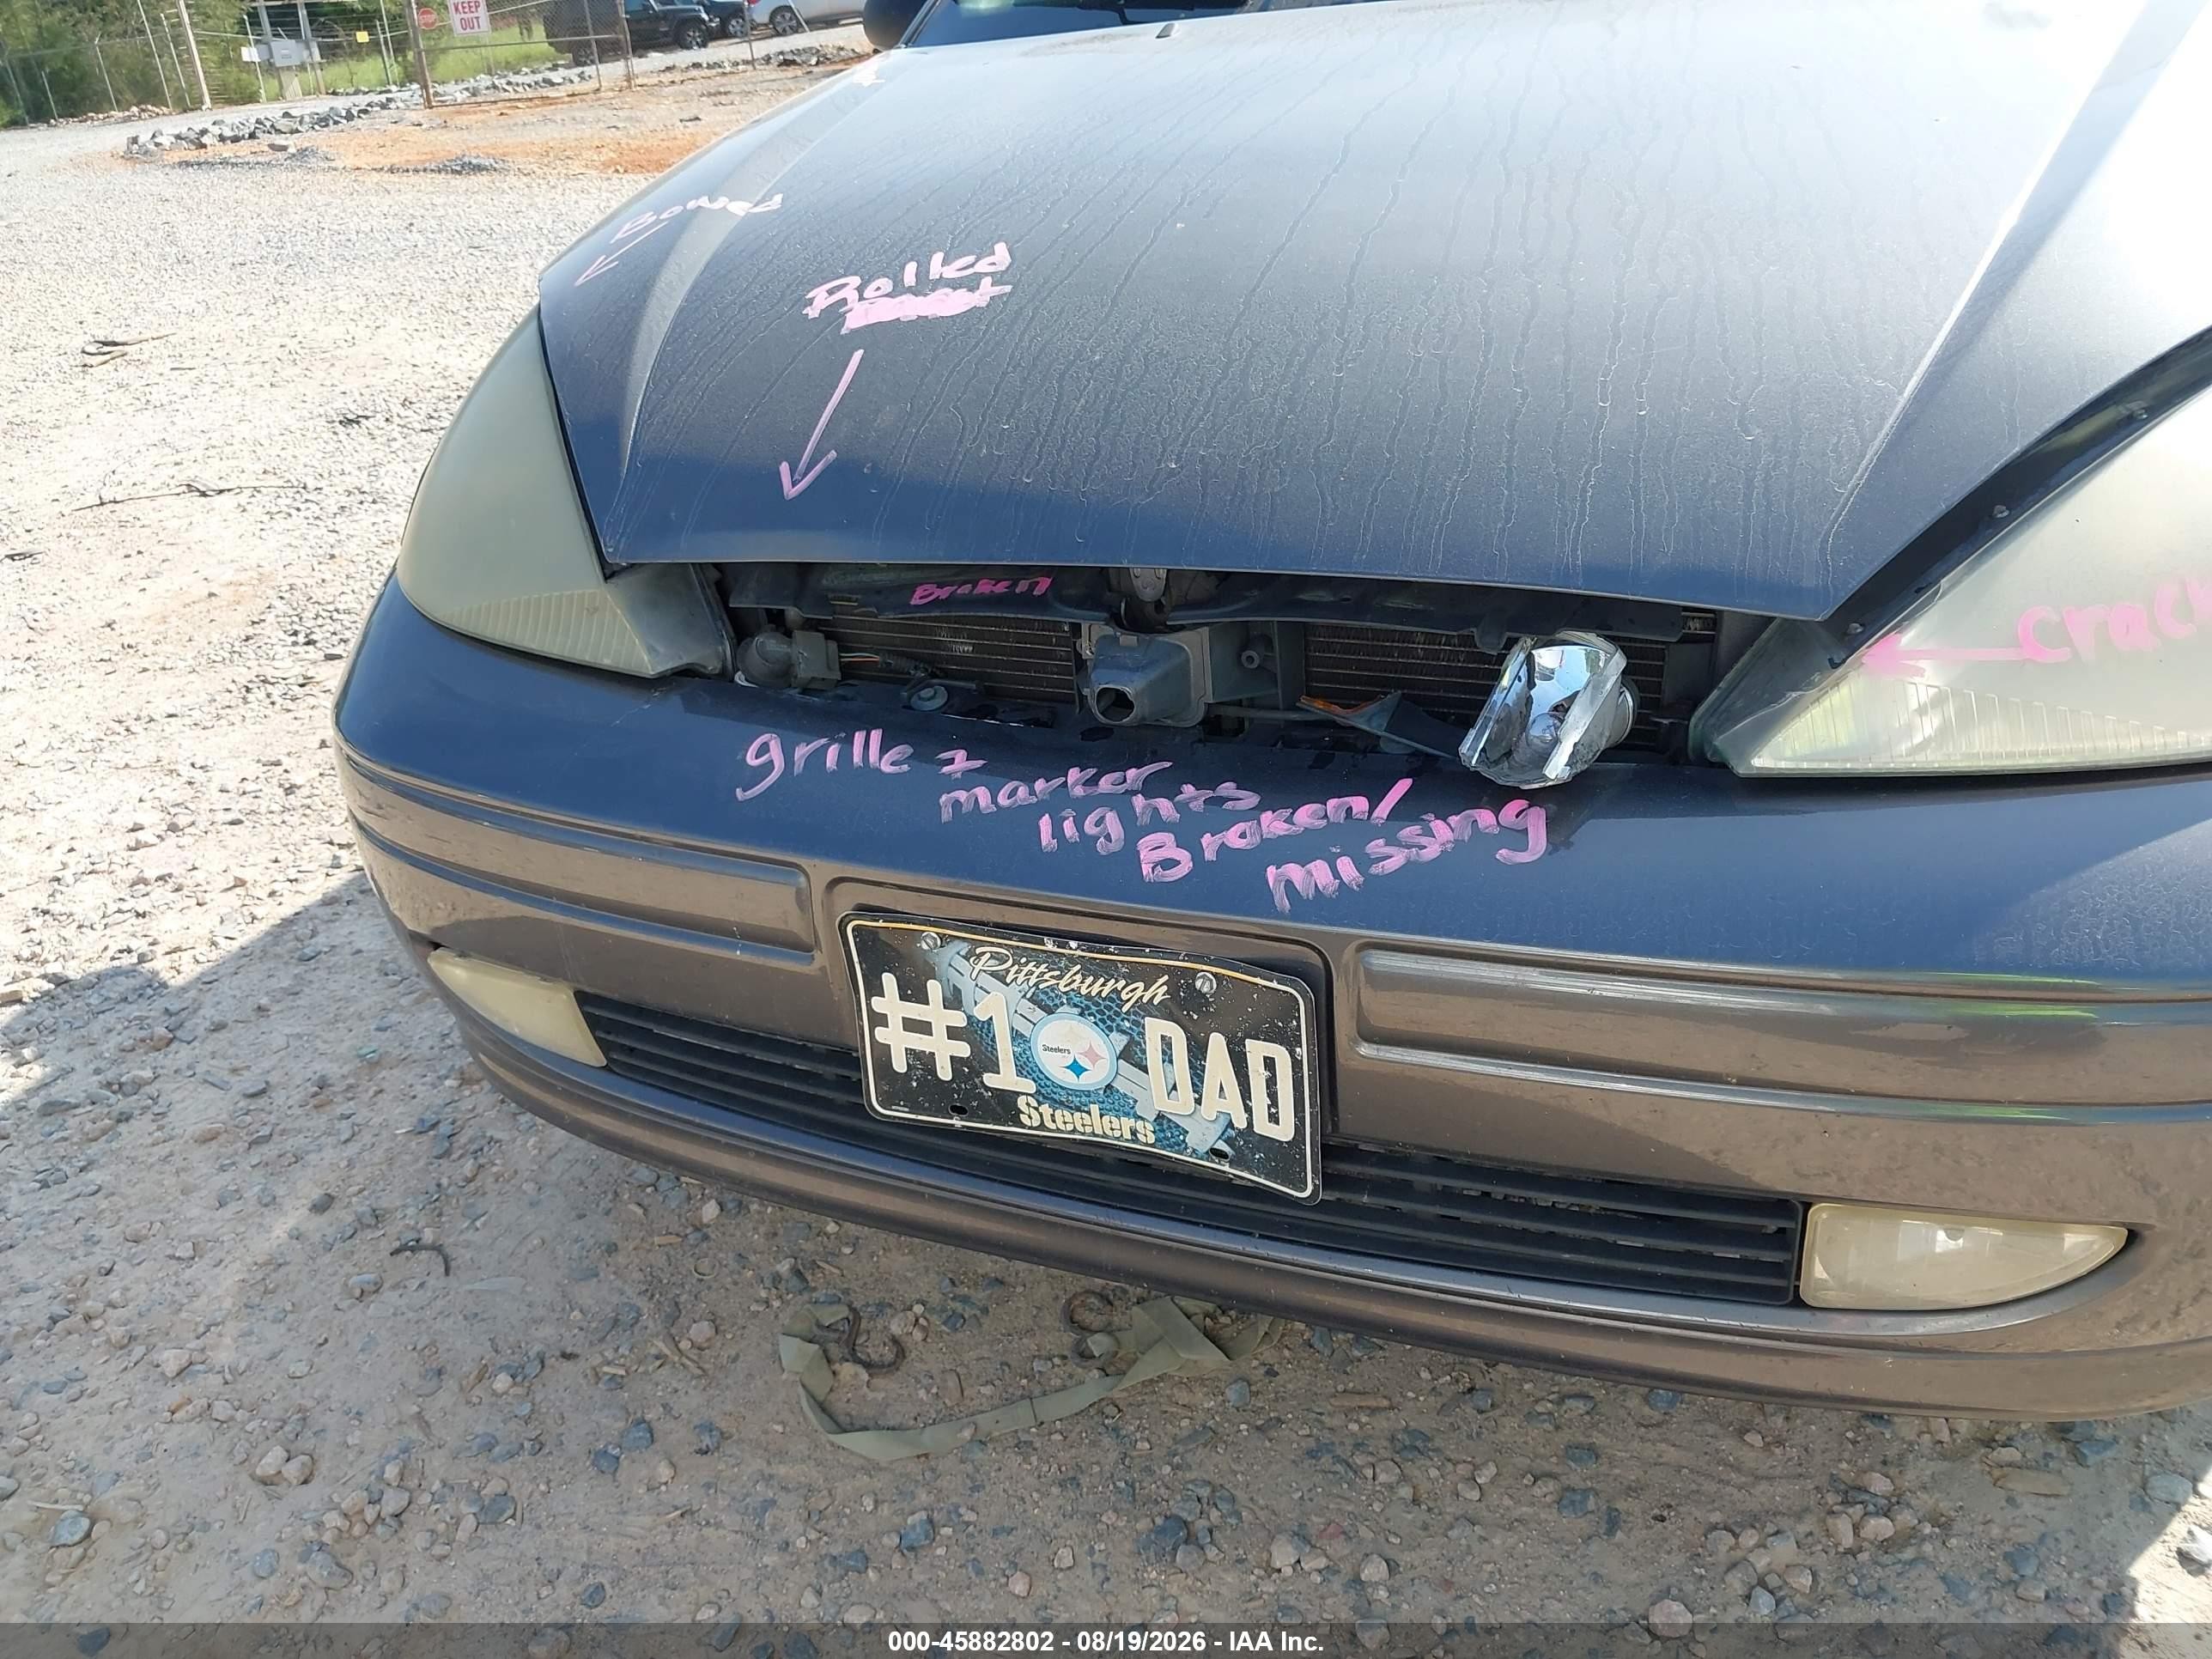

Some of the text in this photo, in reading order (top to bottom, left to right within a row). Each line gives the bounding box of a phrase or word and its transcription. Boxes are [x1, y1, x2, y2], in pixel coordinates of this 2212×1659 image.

[453, 0, 481, 15] KEEP
[460, 16, 481, 31] OUT
[802, 241, 1012, 319] Rolled
[736, 728, 914, 801] grille
[940, 761, 1173, 824] marker
[1037, 781, 1261, 855] lights
[1266, 799, 1547, 914] missing
[969, 947, 1171, 1012] Pittsburgh
[871, 972, 1296, 1142] #1 DAD
[1042, 1043, 1071, 1055] Steelers
[1018, 1095, 1156, 1145] Steelers
